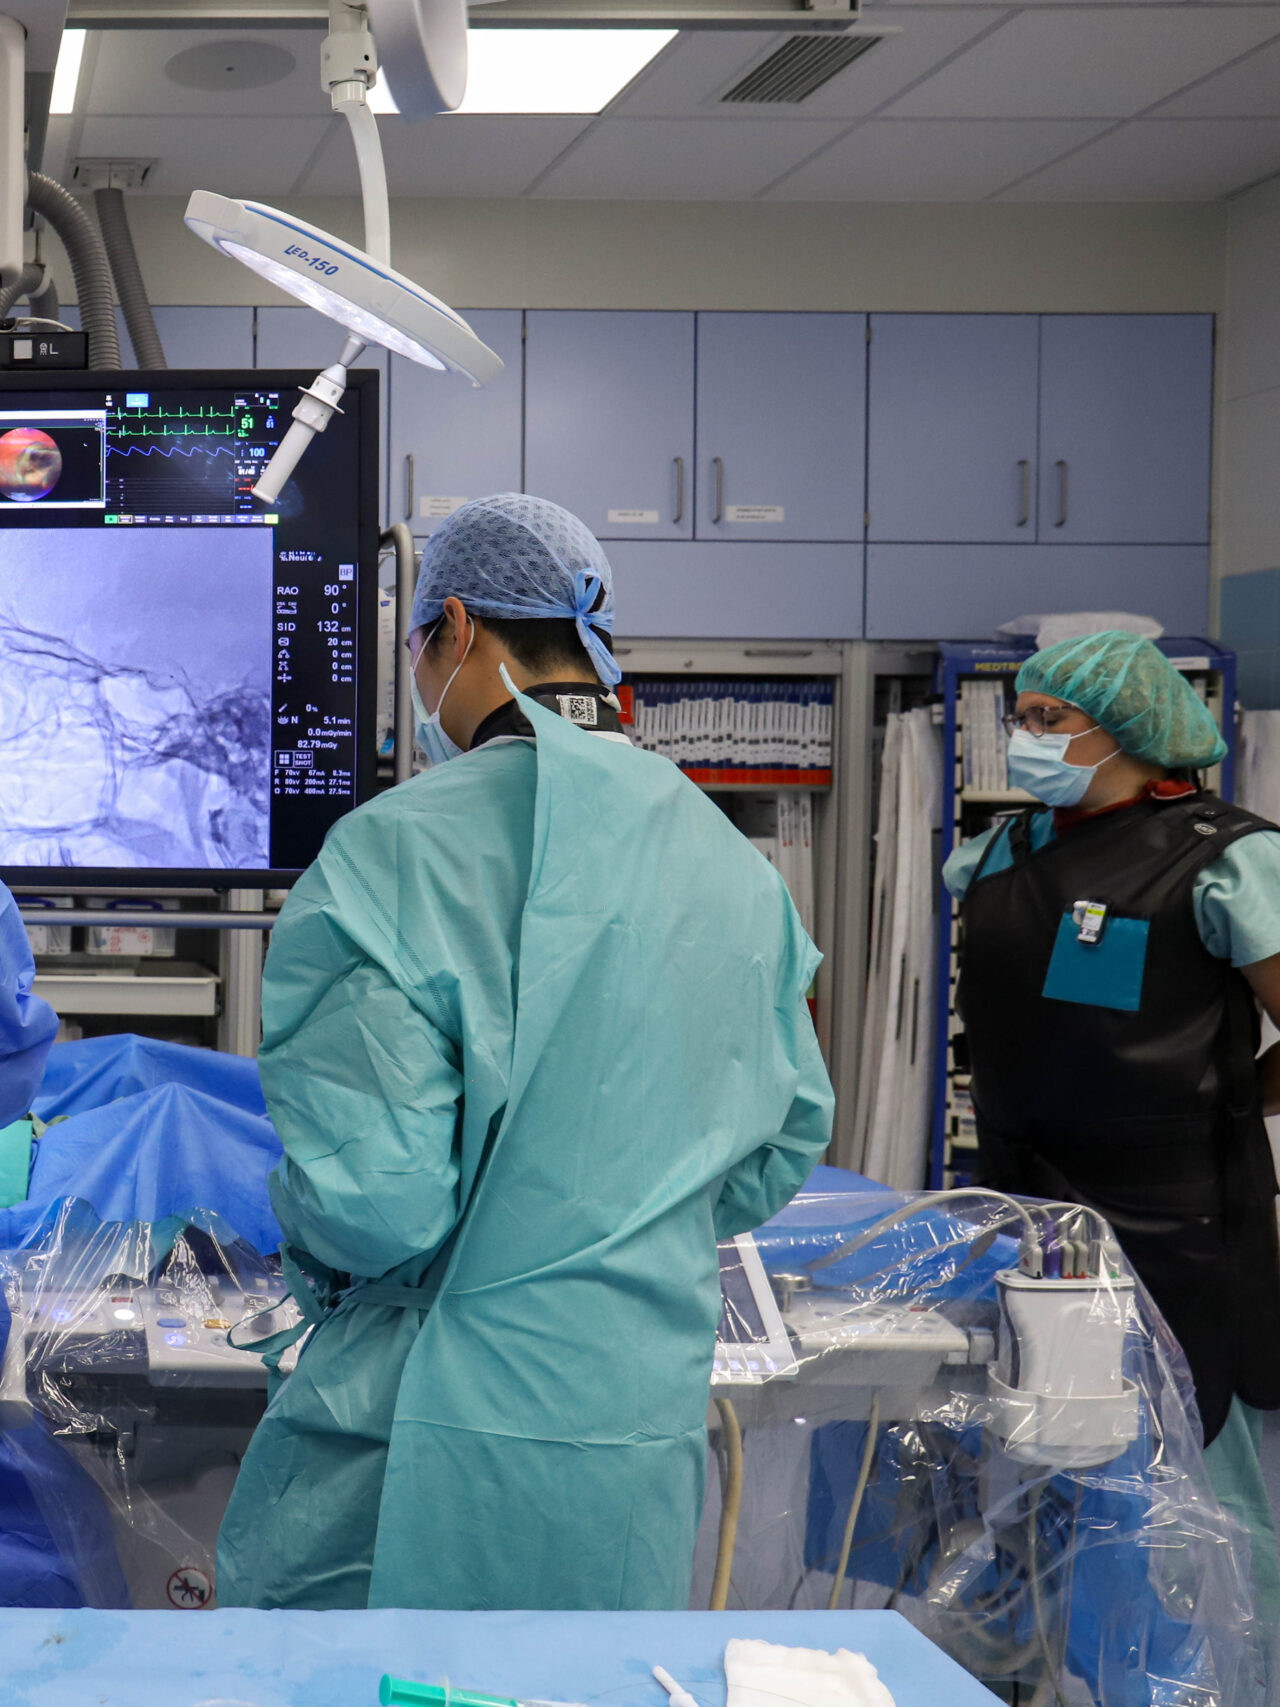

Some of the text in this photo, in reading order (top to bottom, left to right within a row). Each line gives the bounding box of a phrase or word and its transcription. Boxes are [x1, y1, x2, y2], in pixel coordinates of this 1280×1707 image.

[284, 244, 339, 277] LED-150
[241, 417, 253, 429] 51
[249, 447, 265, 457] 100
[276, 586, 299, 595] RAO
[276, 622, 296, 632] SID
[317, 621, 339, 633] 132
[327, 637, 338, 646] 20
[332, 649, 338, 658] 0
[332, 662, 338, 670] 0
[332, 674, 338, 682] 0
[291, 716, 298, 724] N
